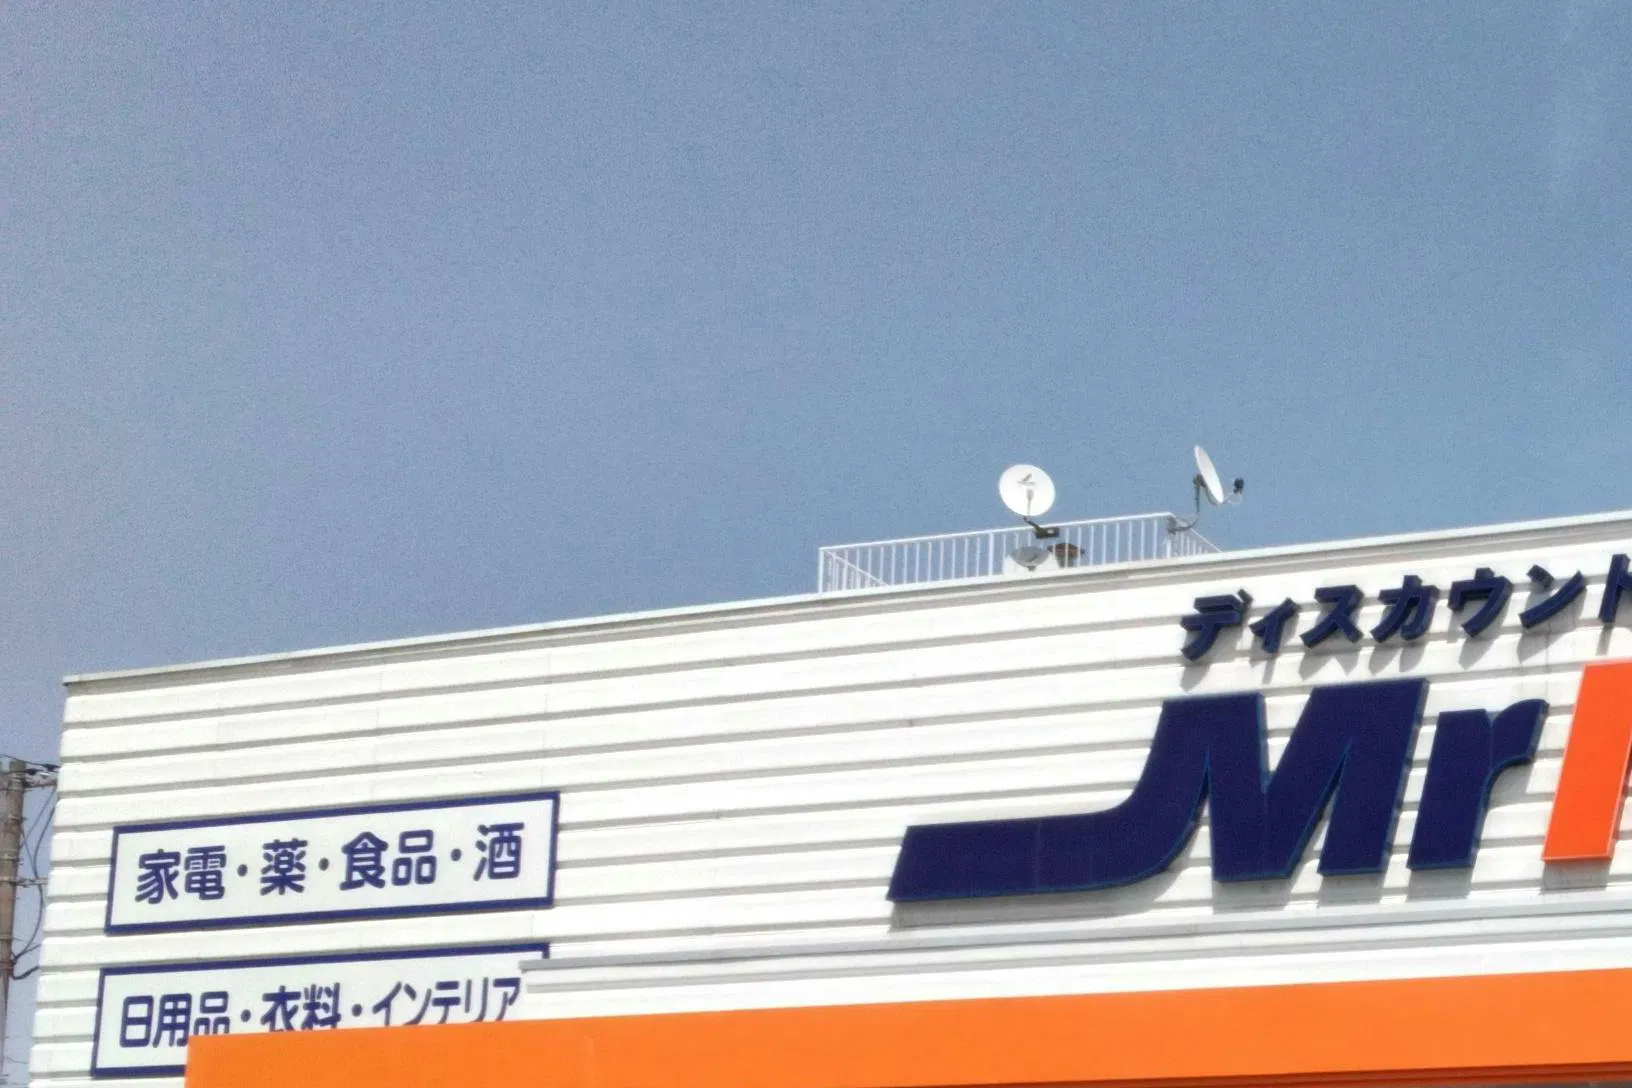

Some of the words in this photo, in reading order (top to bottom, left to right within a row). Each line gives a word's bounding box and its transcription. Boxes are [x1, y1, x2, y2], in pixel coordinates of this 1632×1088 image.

[135, 822, 524, 904] 家電・薬・食品・酒
